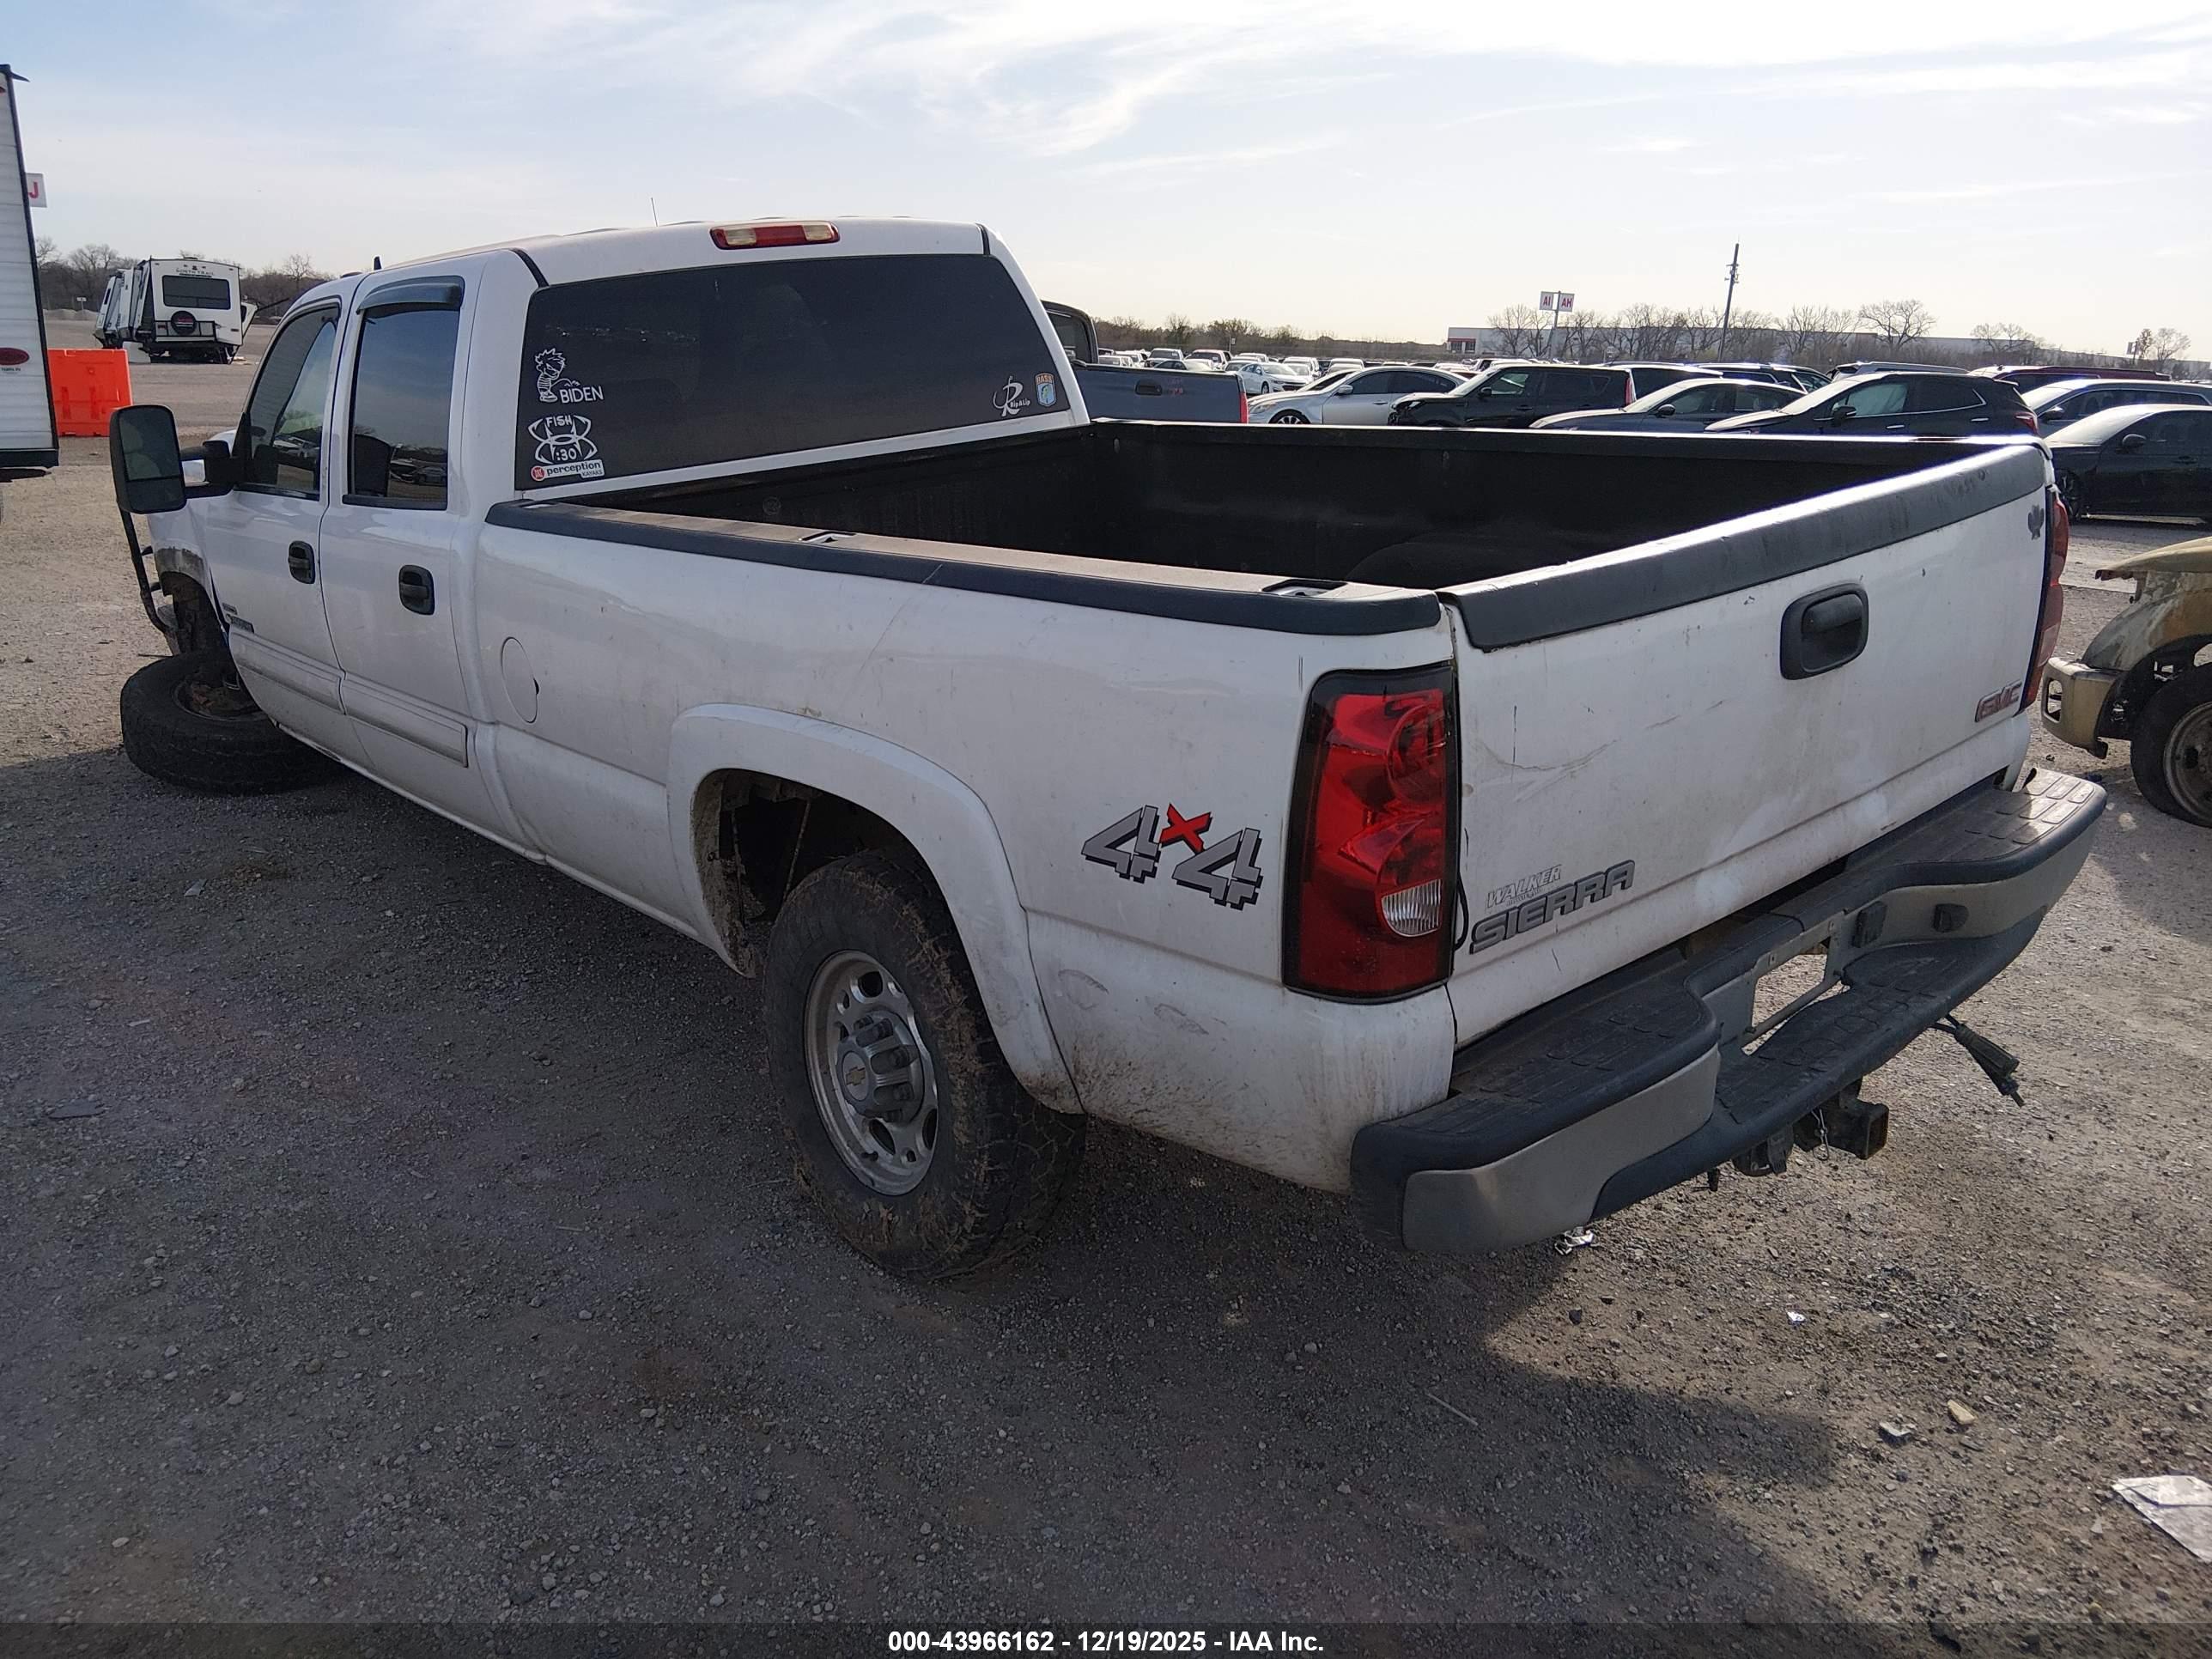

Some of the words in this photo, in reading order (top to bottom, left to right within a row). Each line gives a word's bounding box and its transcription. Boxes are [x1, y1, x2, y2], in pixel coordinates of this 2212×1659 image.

[1542, 295, 1552, 307] AI
[1561, 297, 1573, 308] AH
[559, 386, 605, 404] BIDEN
[545, 415, 573, 428] FISH
[546, 461, 601, 477] perception
[1974, 678, 2023, 723] GMC
[1486, 864, 1563, 908] WALKER
[1468, 859, 1636, 956] SIERRA
